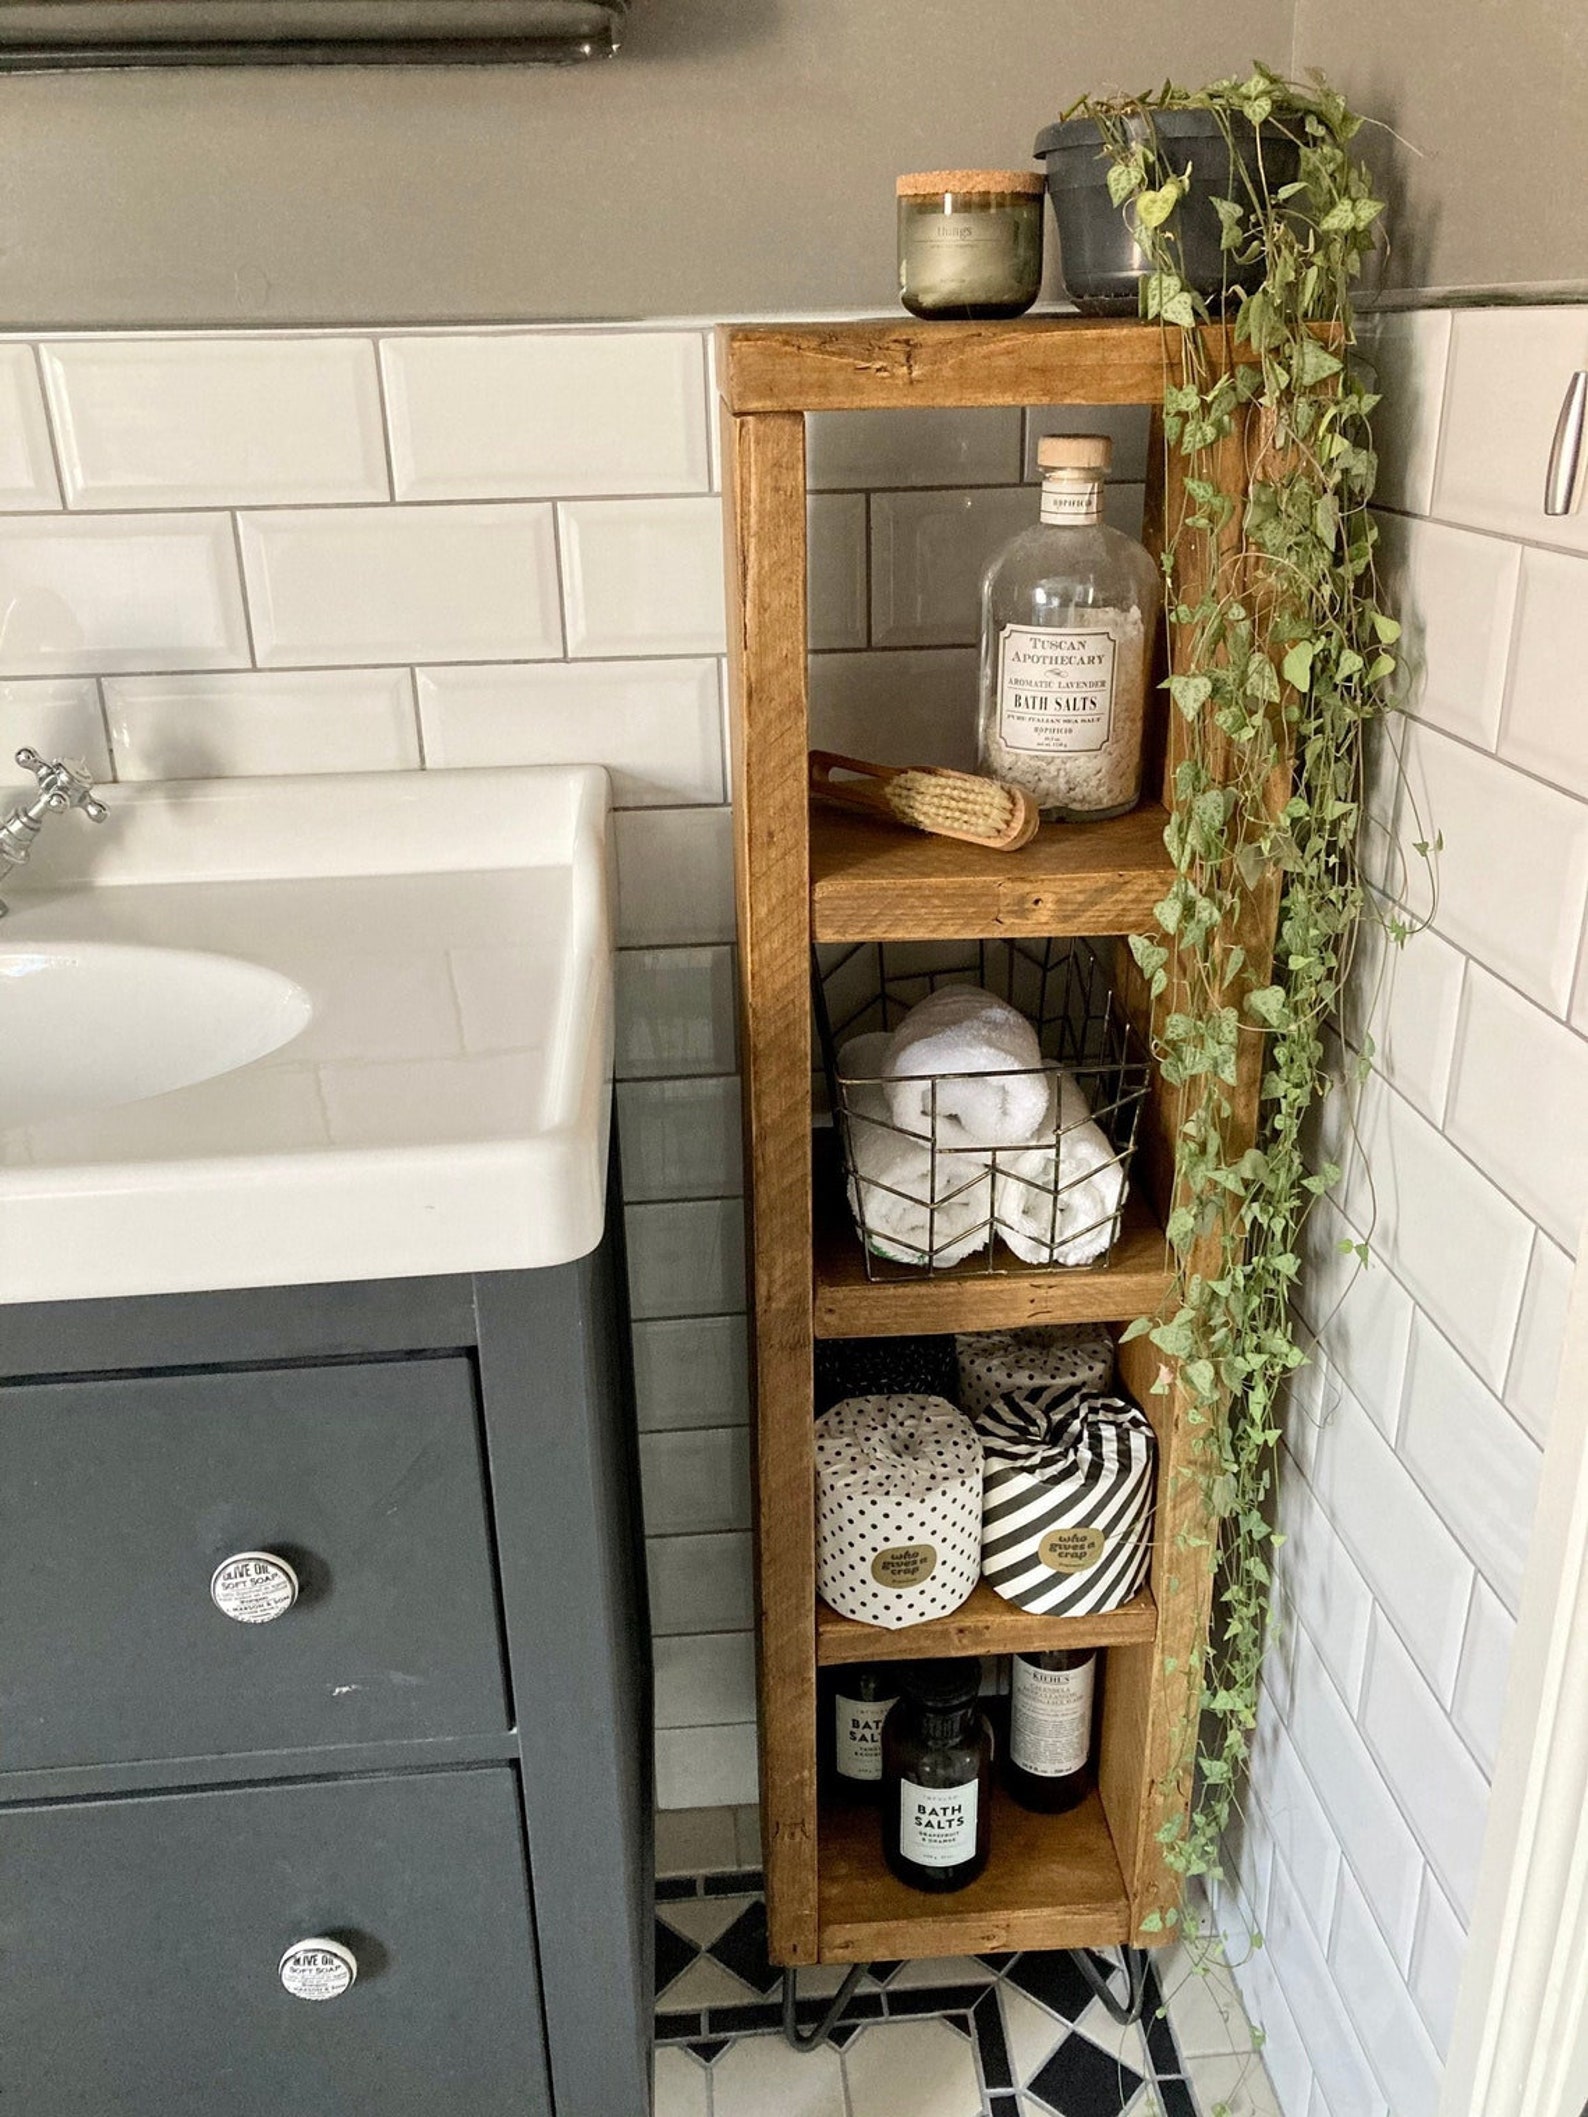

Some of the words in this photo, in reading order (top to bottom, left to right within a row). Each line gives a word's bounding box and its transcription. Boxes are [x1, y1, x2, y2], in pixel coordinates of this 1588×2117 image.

[1029, 637, 1087, 651] TUSCAN
[1011, 651, 1106, 665] APOTHECARY
[1008, 678, 1054, 688] AROMATIC
[1058, 680, 1107, 689] LAVENDER
[1014, 693, 1048, 711] BATH
[1054, 695, 1098, 712] SALTS
[1058, 1533, 1088, 1543] who
[1048, 1542, 1086, 1553] gives
[890, 1550, 920, 1560] who
[1058, 1551, 1088, 1560] crap
[881, 1558, 918, 1571] gives
[890, 1566, 920, 1575] crap
[222, 1563, 251, 1581] OLIVE
[254, 1562, 271, 1575] OIL
[221, 1580, 248, 1590] SOFT
[851, 1718, 883, 1731] BAT
[848, 1730, 882, 1743] SAL
[917, 1804, 962, 1816] BATH
[914, 1816, 965, 1829] SALTS
